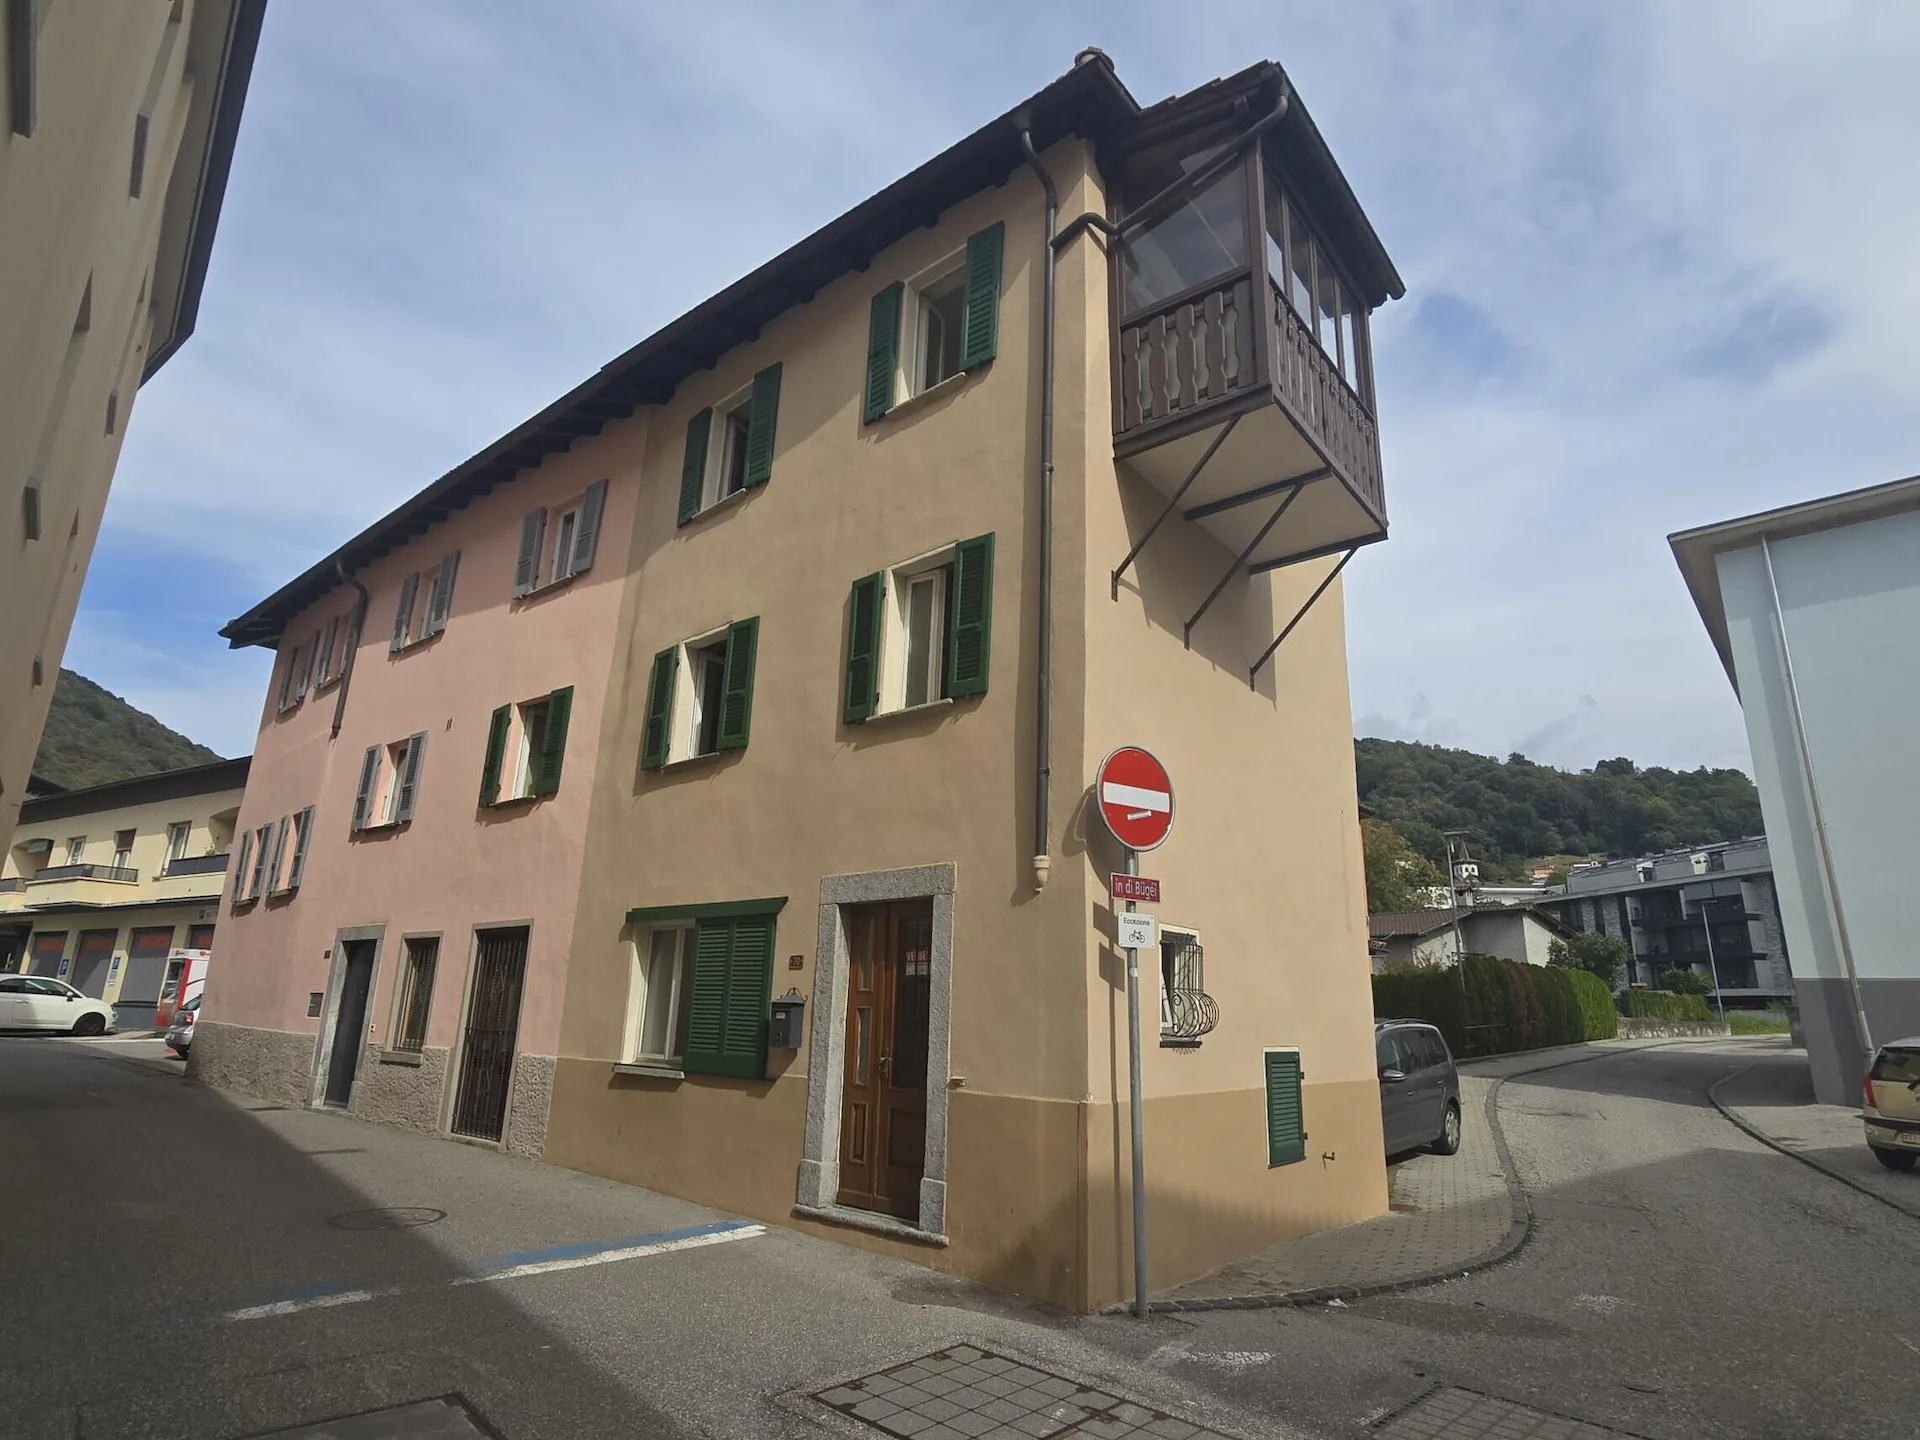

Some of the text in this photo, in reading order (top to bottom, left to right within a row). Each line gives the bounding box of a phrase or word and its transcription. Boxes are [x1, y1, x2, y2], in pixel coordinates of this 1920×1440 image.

[1115, 878, 1123, 893] in
[1125, 879, 1133, 894] di
[1123, 917, 1150, 926] Eccezione
